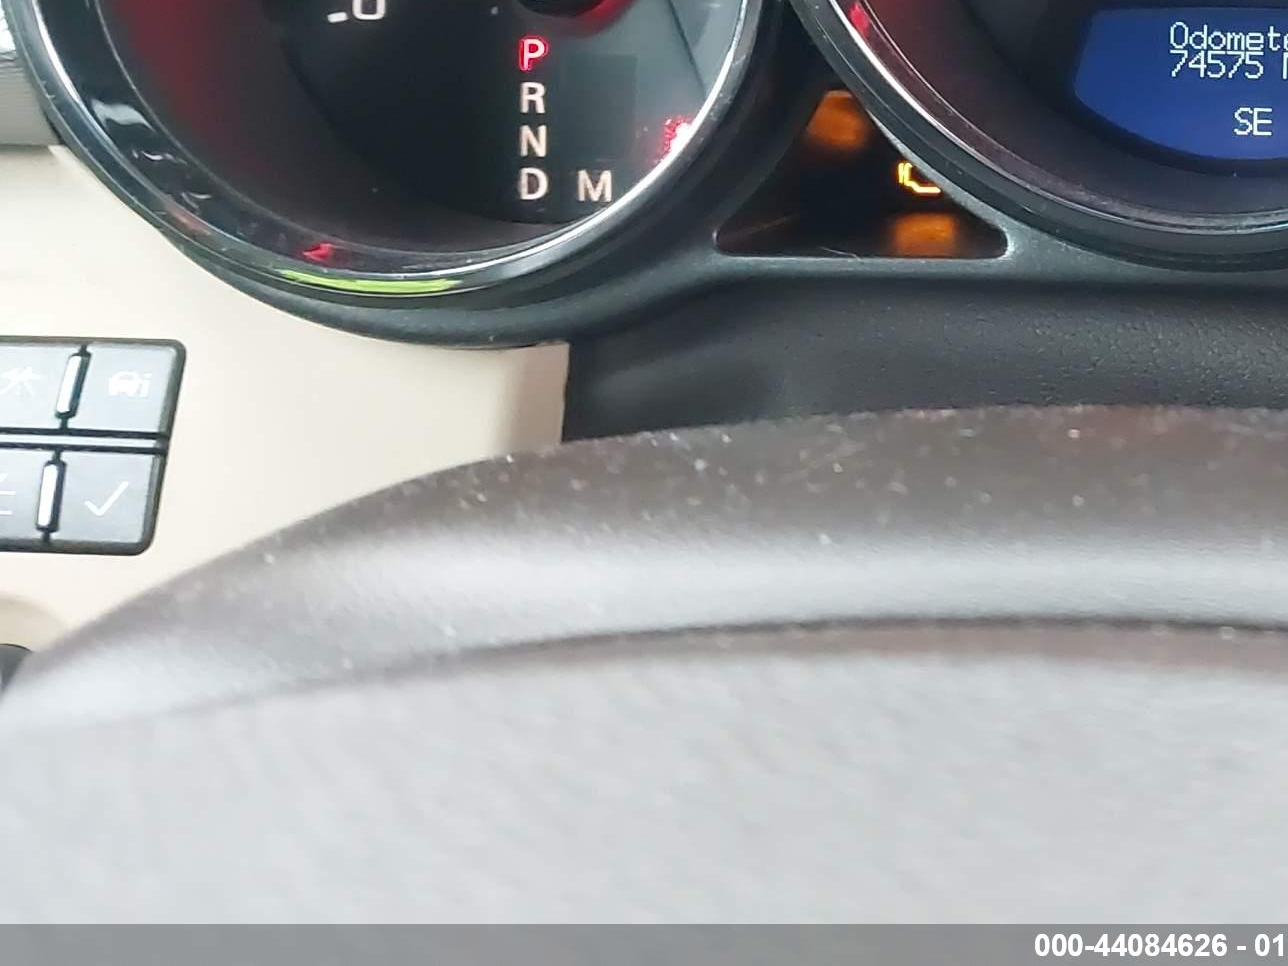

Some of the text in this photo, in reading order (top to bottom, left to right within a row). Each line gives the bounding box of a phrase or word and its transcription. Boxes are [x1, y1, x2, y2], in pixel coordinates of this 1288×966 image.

[521, 37, 548, 71] P
[1169, 49, 1264, 79] 74575
[521, 81, 546, 114] R
[1233, 106, 1273, 136] SE
[521, 125, 547, 157] N
[520, 168, 548, 201] D
[578, 169, 612, 202] M
